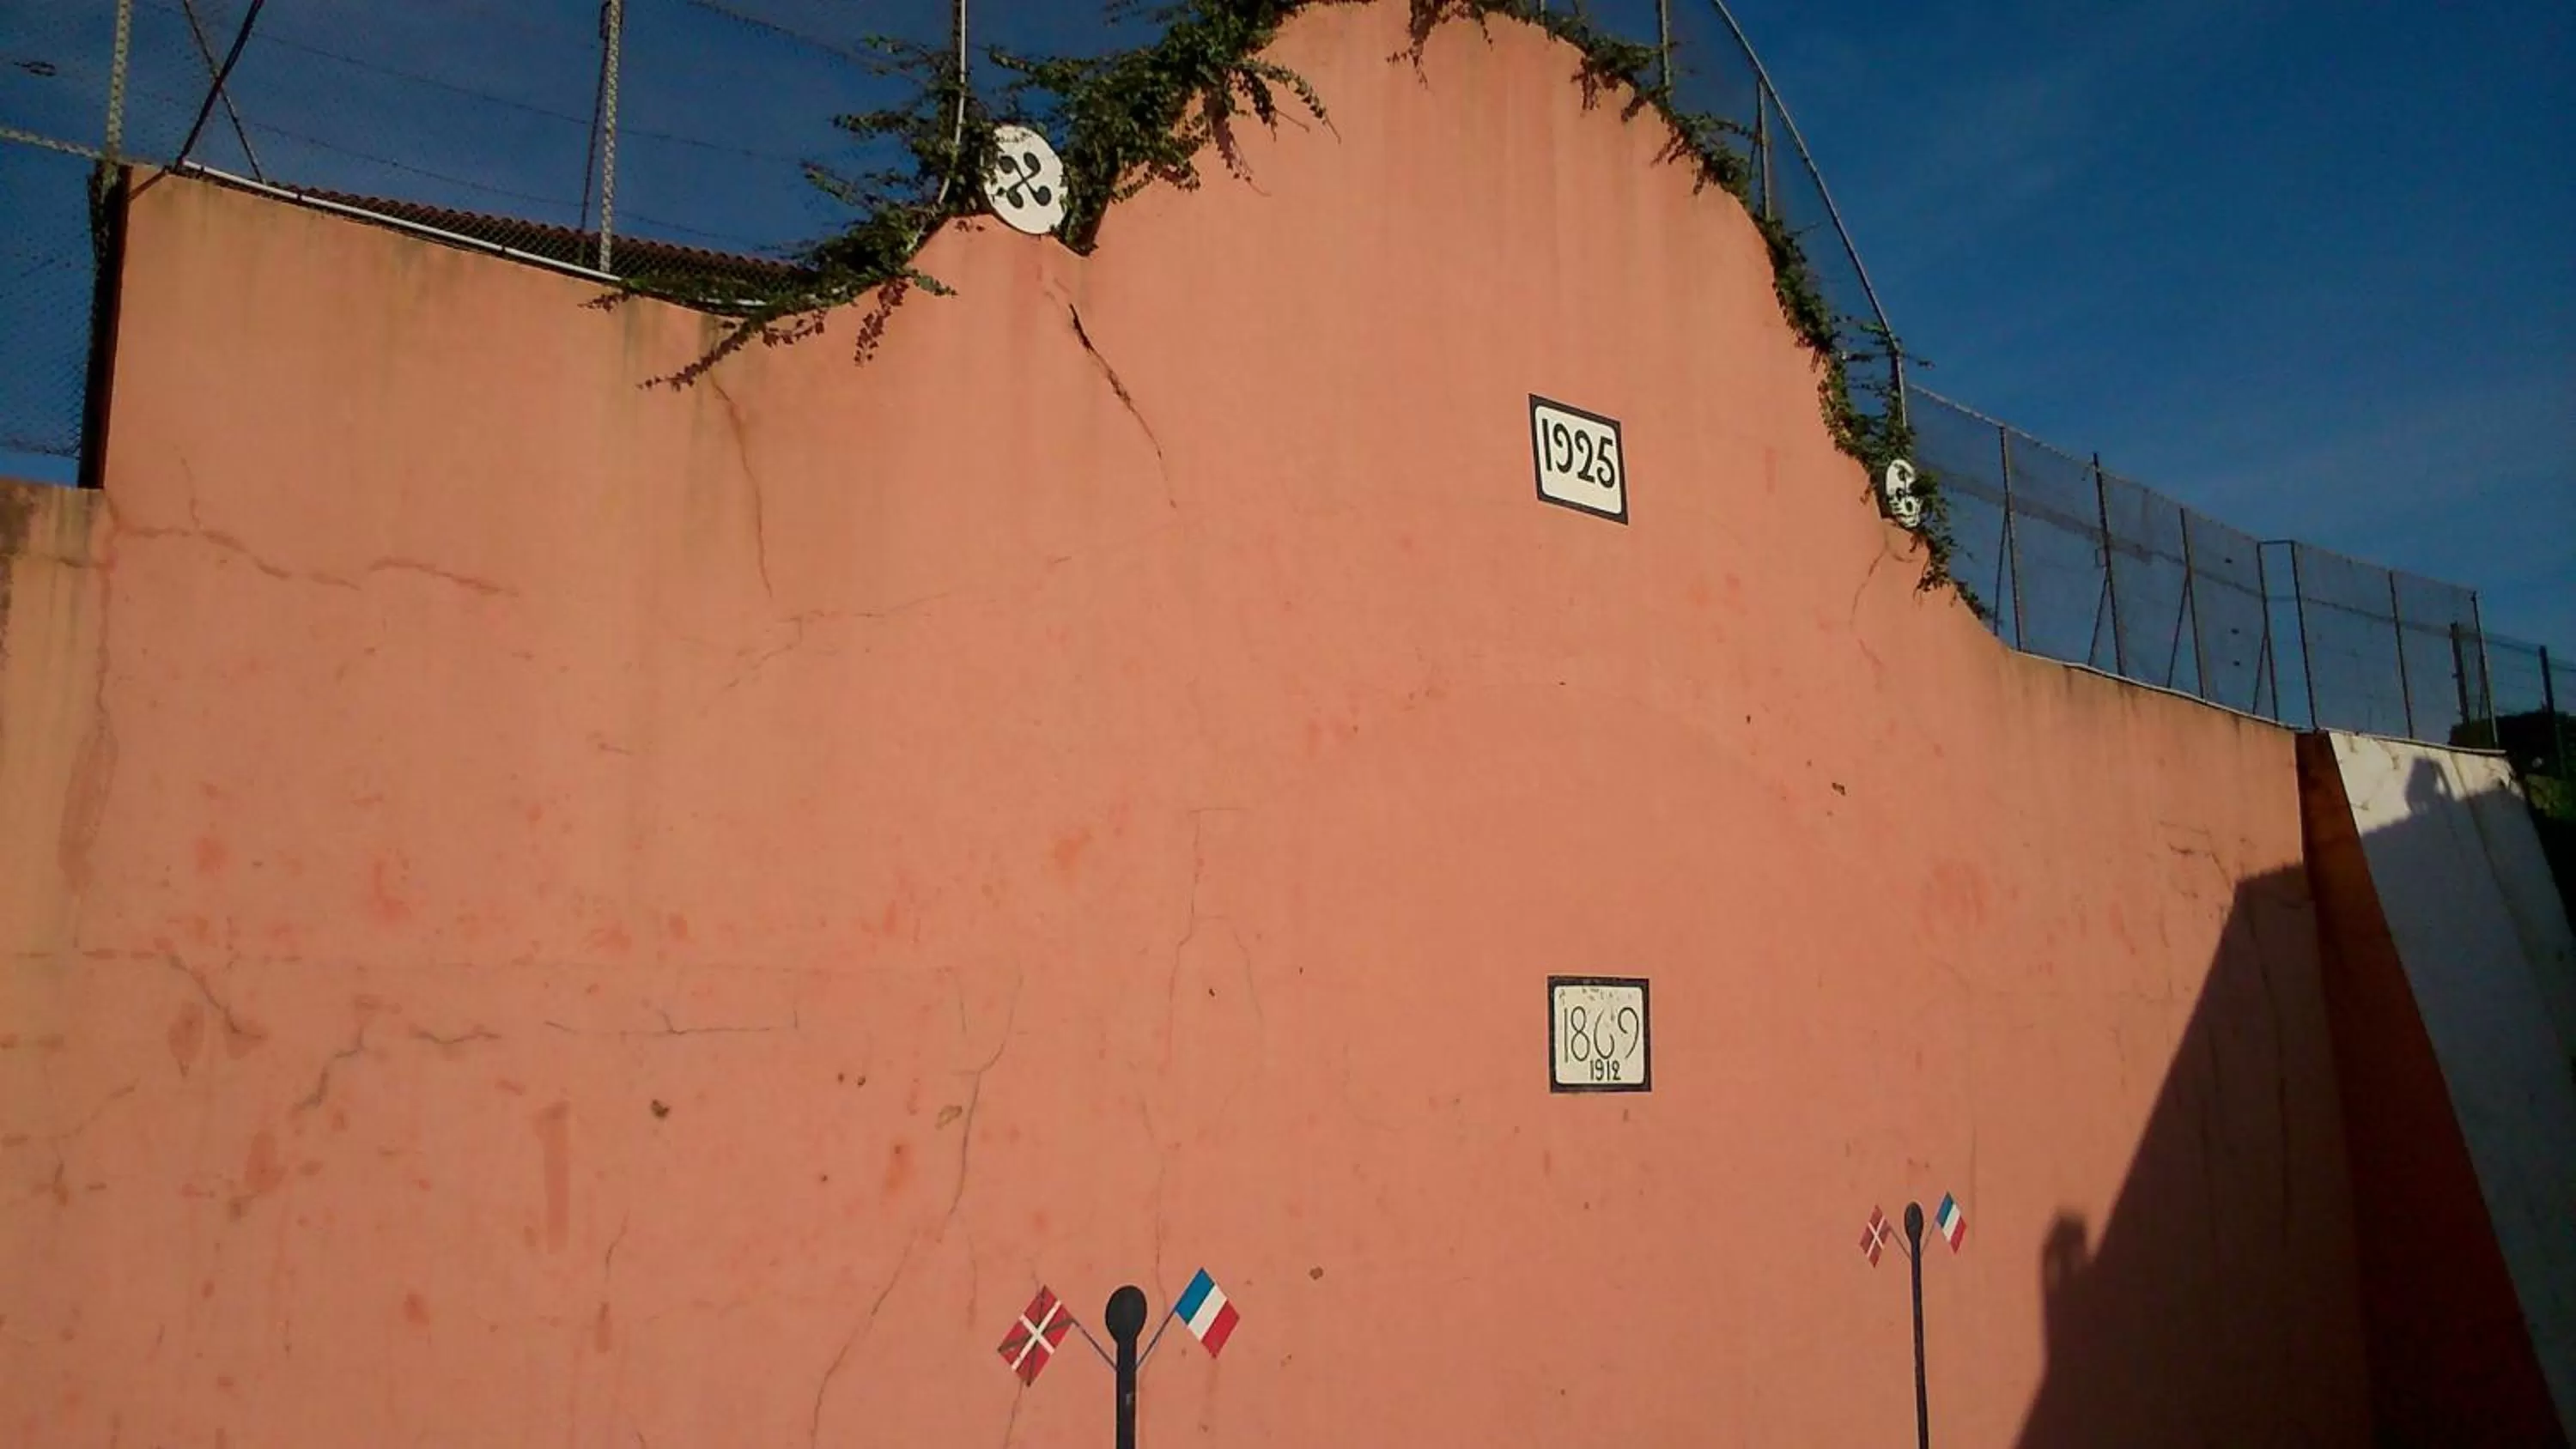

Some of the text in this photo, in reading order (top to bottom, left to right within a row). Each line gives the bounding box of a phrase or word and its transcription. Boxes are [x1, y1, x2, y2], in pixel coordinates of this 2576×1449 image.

[1542, 418, 1616, 488] 1925
[1564, 1005, 1639, 1063] 1869
[1589, 1058, 1621, 1082] 1912
